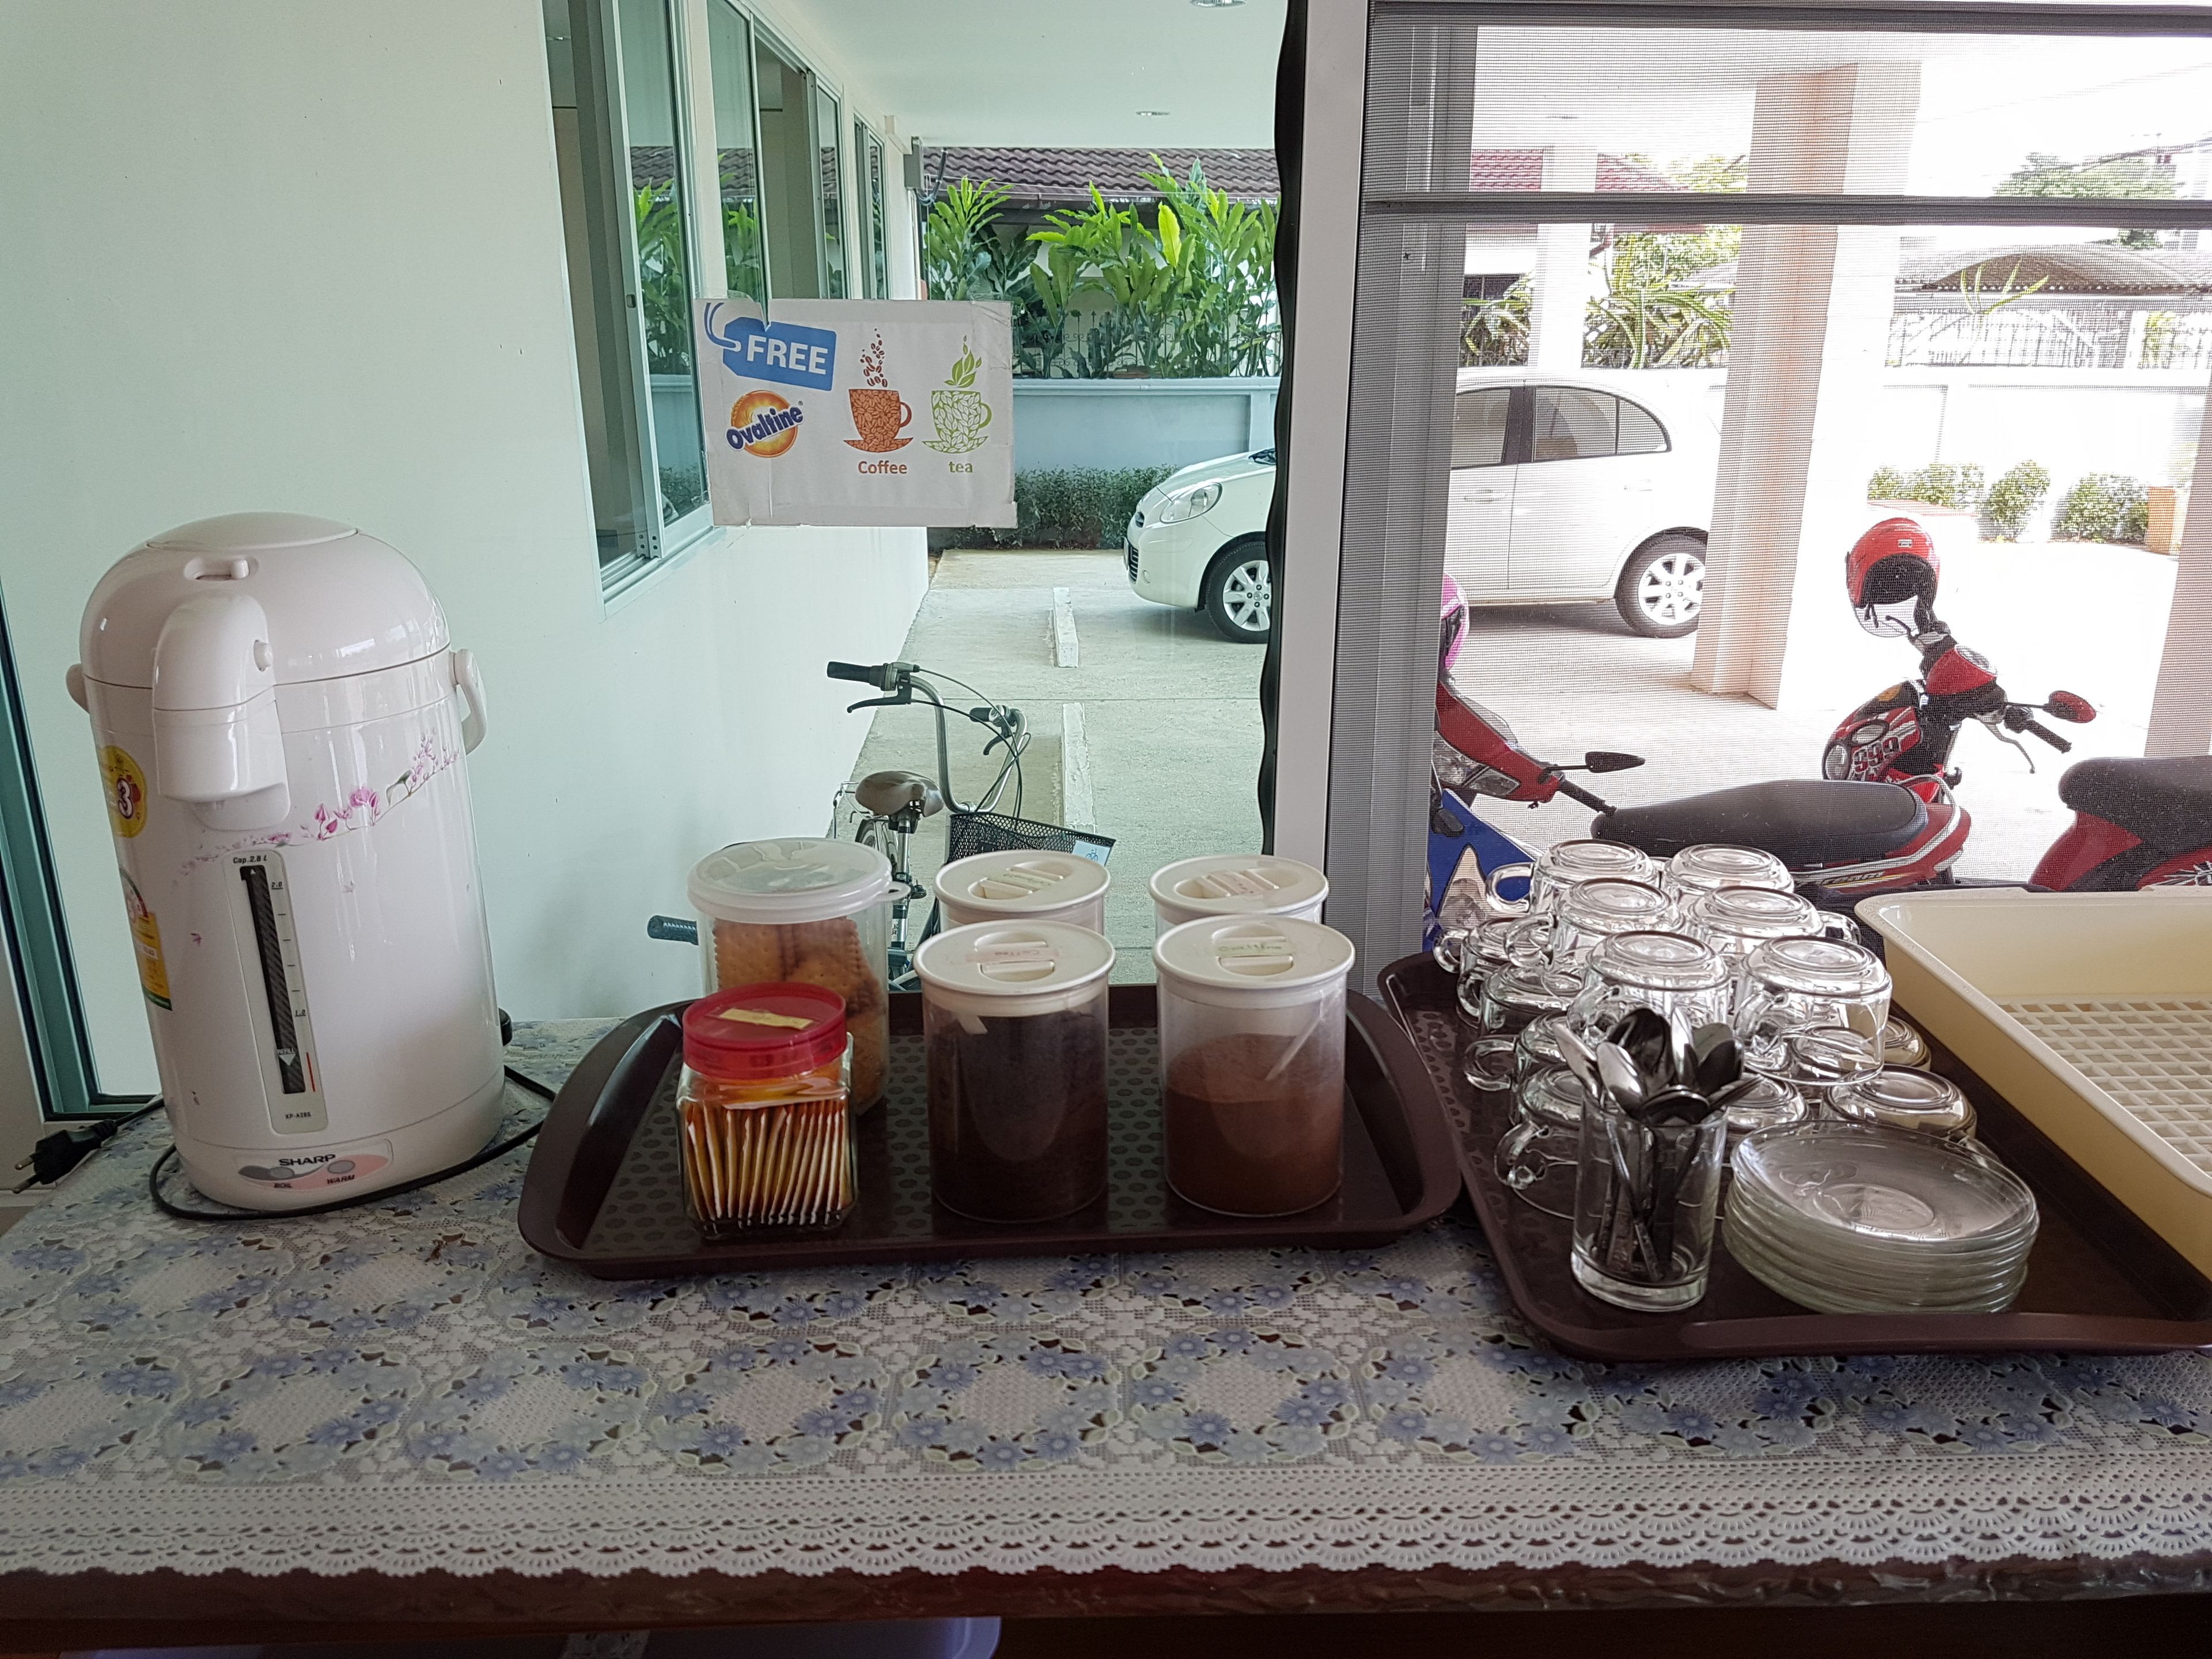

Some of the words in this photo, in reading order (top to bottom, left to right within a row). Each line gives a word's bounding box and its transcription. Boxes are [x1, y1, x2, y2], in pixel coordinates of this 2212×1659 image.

[747, 335, 828, 374] FREE
[726, 404, 803, 450] Ovaltine
[858, 460, 908, 474] Coffee
[948, 461, 974, 474] tea
[279, 1154, 336, 1166] SHARP
[327, 1175, 355, 1184] WARM
